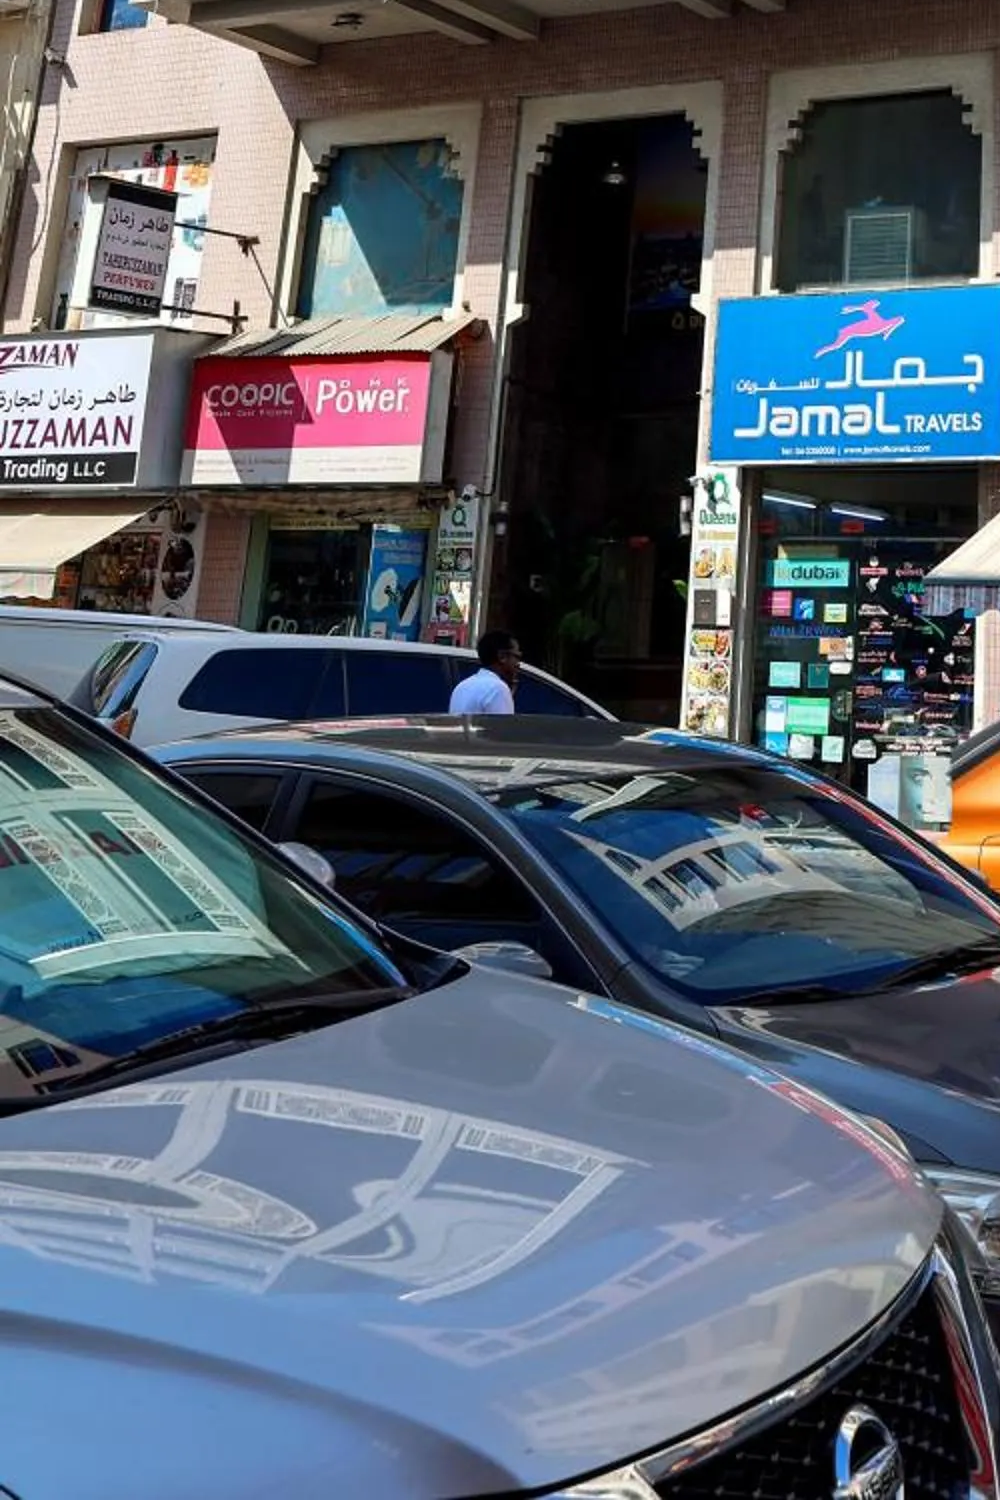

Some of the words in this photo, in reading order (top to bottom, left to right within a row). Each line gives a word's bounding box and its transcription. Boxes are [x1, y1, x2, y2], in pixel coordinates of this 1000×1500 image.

[825, 350, 985, 393] جمال
[48, 388, 83, 411] زمان
[88, 383, 137, 411] طاهر
[316, 378, 410, 416] Power
[904, 412, 983, 433] TRAVELS
[4, 458, 69, 481] Trading
[73, 461, 106, 477] LLC
